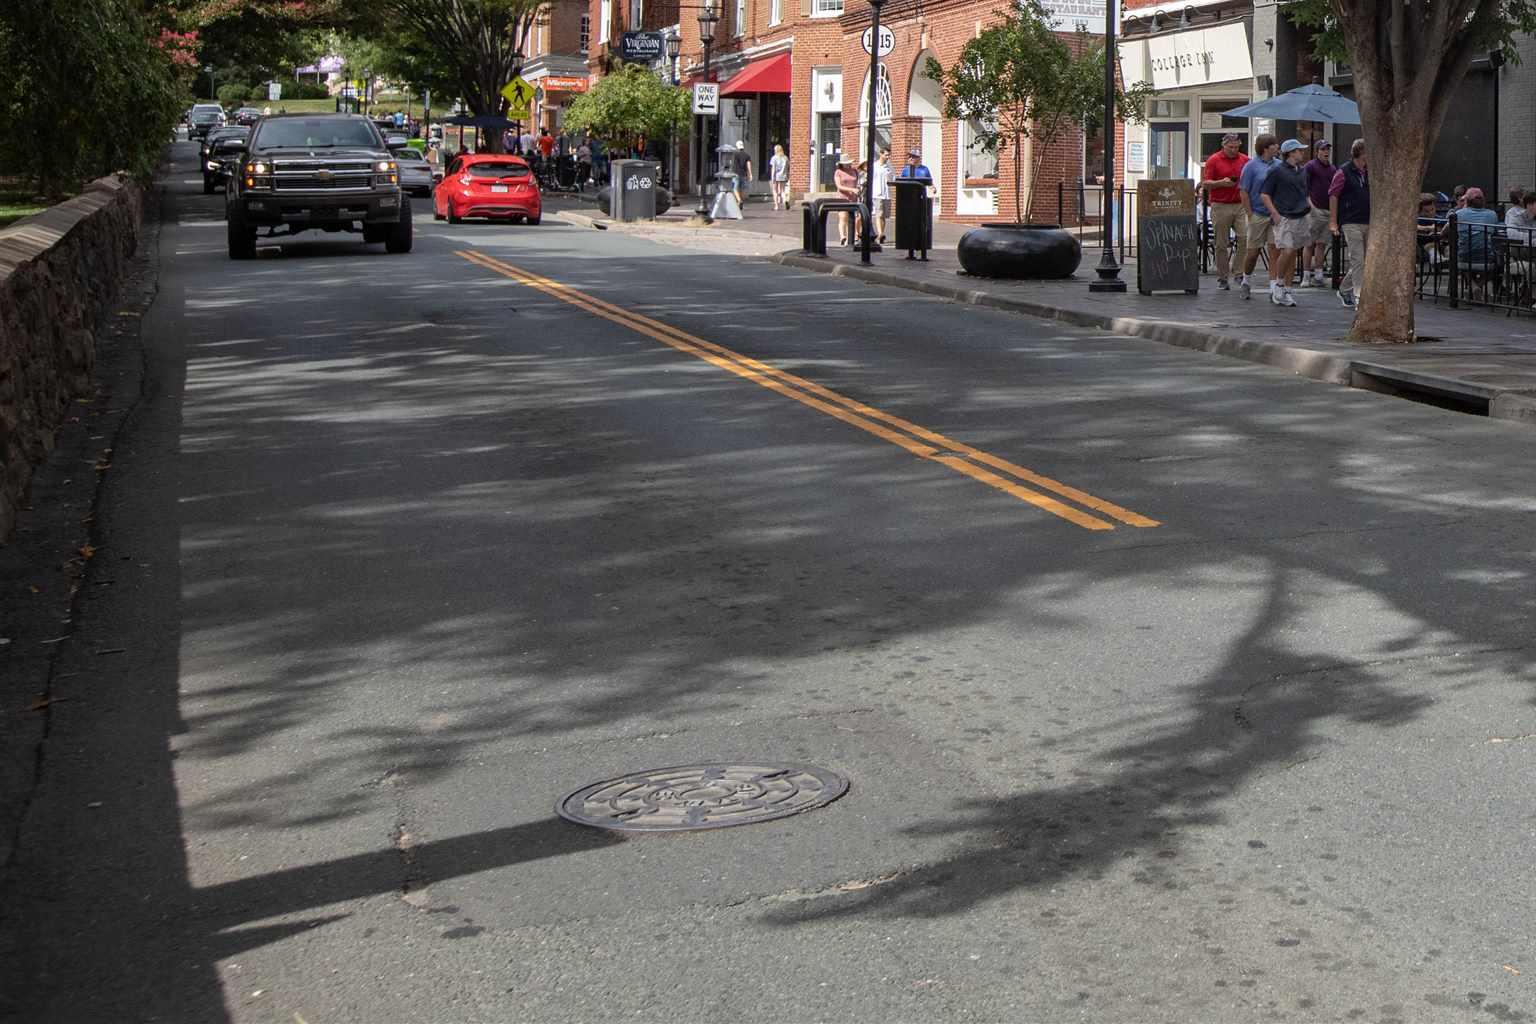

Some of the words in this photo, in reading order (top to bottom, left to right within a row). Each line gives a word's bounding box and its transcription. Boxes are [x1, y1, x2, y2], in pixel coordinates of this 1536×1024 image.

[866, 33, 891, 48] 115
[698, 86, 715, 94] ONE
[697, 94, 715, 102] WAY
